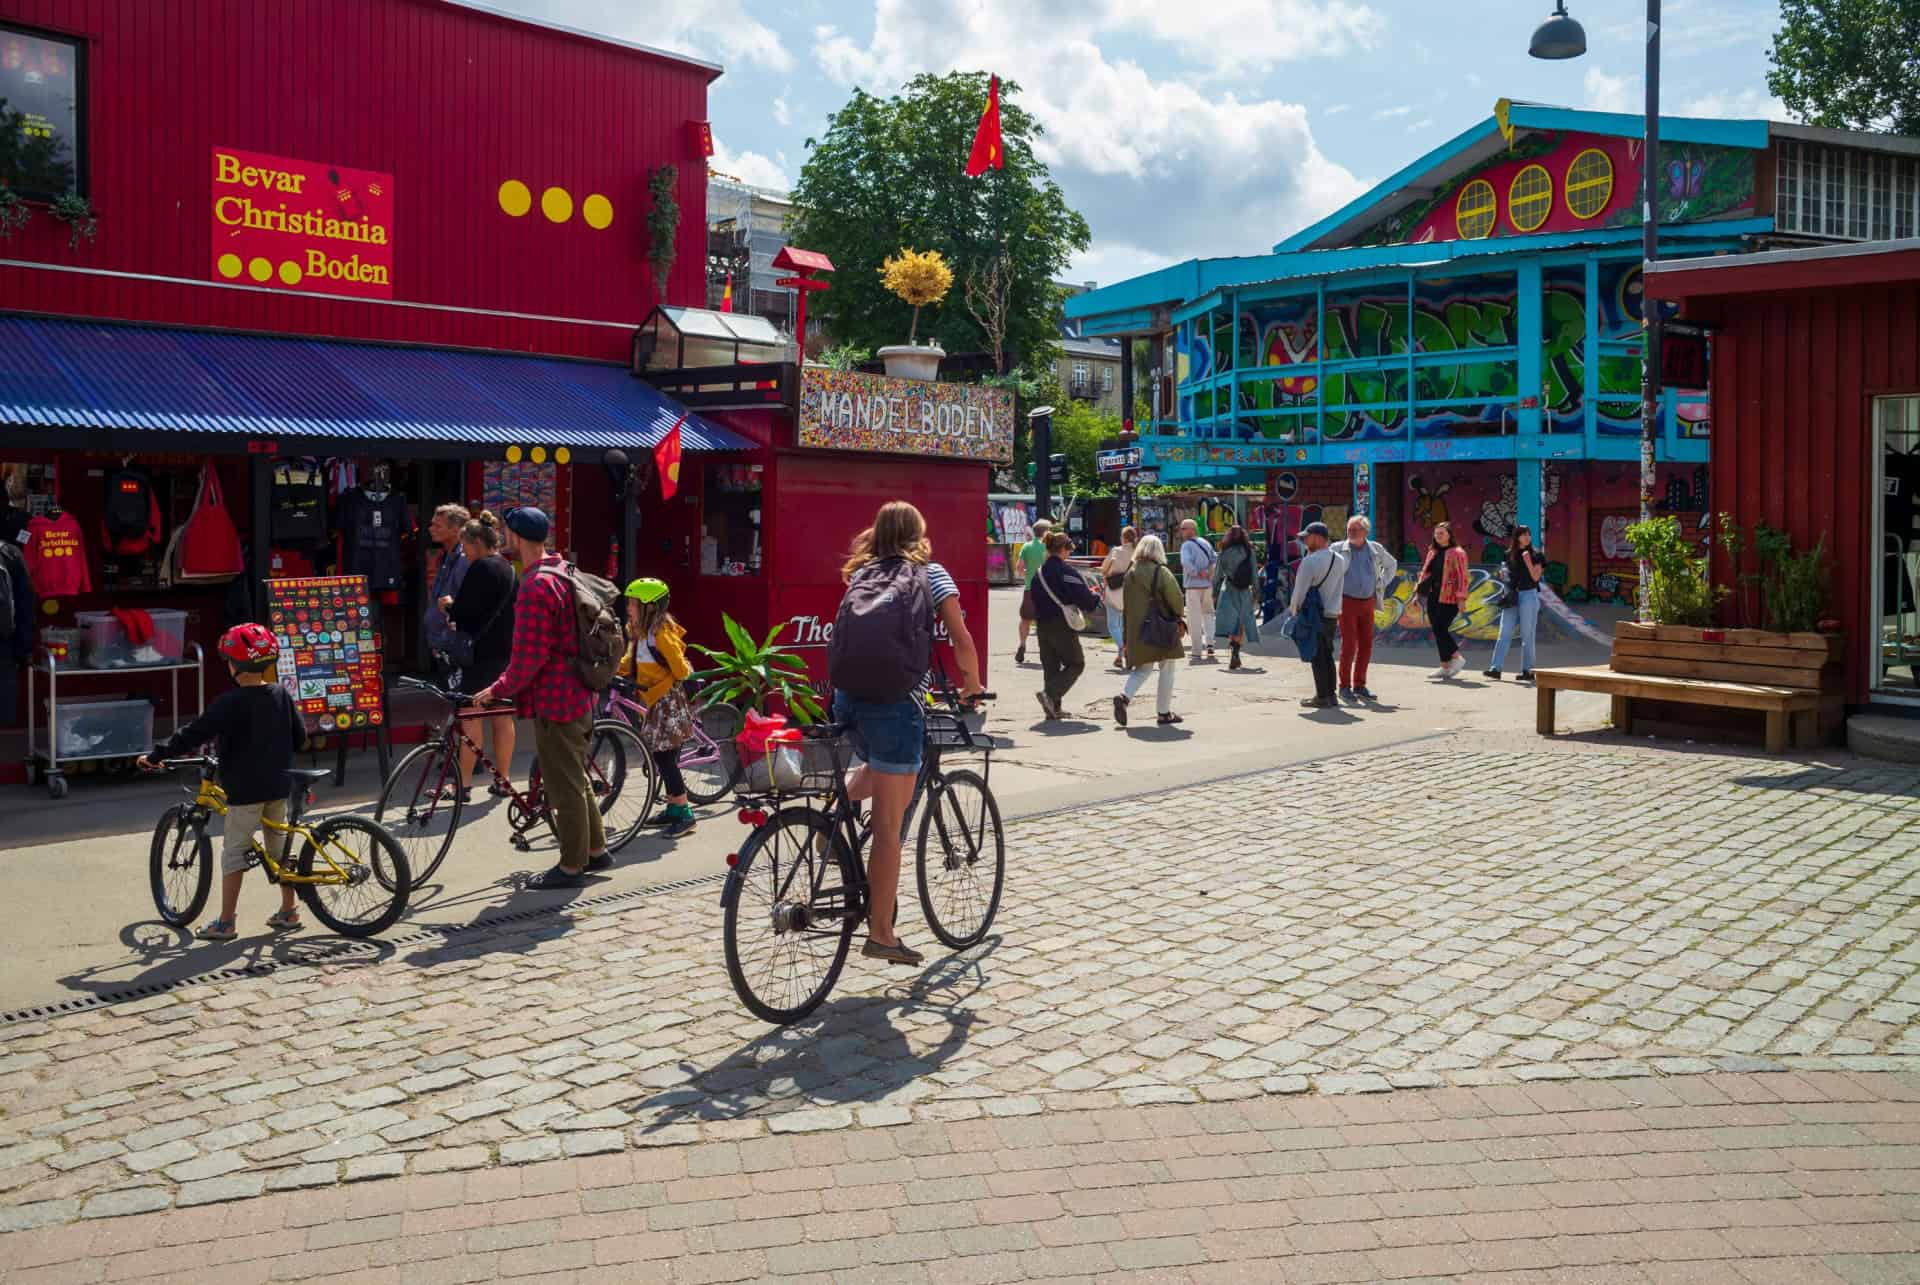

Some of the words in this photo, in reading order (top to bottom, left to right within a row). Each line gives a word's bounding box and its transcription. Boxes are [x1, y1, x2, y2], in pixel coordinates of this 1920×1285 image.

[215, 153, 307, 194] Bevar
[214, 195, 388, 246] Christiania
[305, 248, 389, 285] Boden
[820, 391, 994, 441] MANDELBODEN
[789, 615, 834, 643] The
